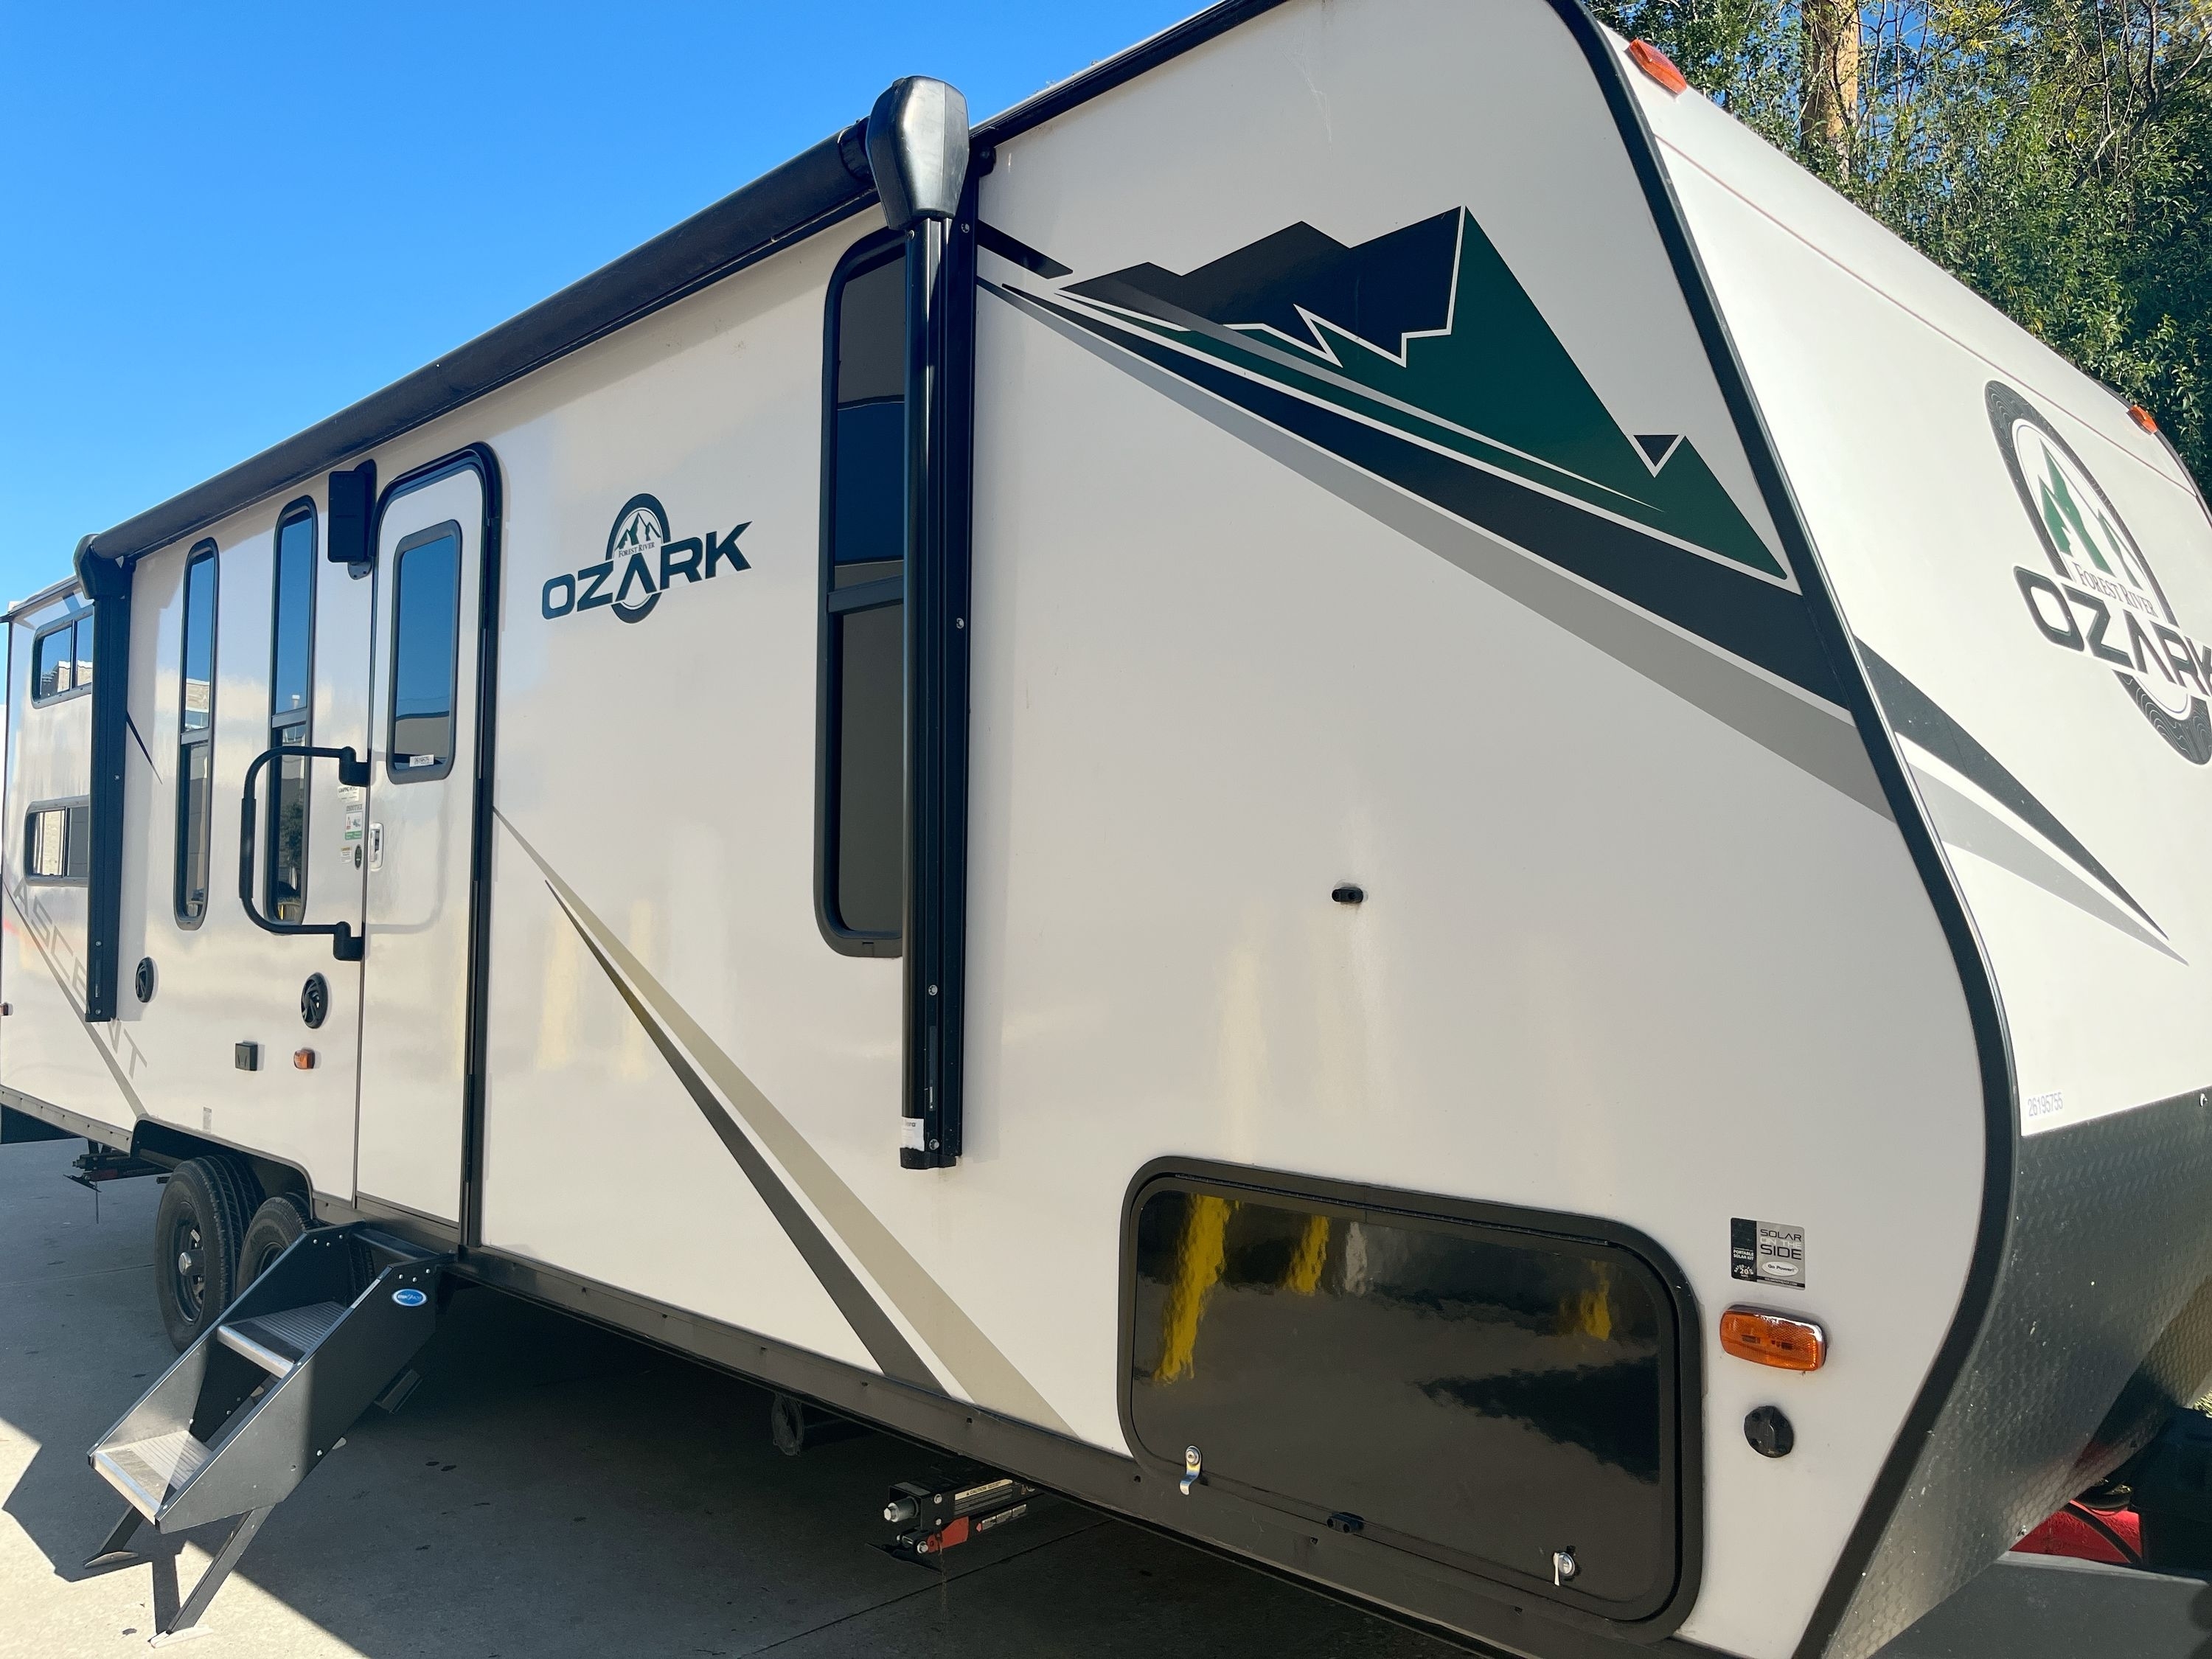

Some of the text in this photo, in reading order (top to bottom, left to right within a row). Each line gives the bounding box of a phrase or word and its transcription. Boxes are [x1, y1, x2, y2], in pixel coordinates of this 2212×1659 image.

[618, 541, 655, 557] FOREST RIVER
[542, 521, 753, 620] OZARK
[2072, 562, 2159, 618] FOREST RIVER
[1760, 1228, 1802, 1242] SOLAR
[1760, 1237, 1802, 1249] ON THE
[1760, 1244, 1802, 1260] SIDE
